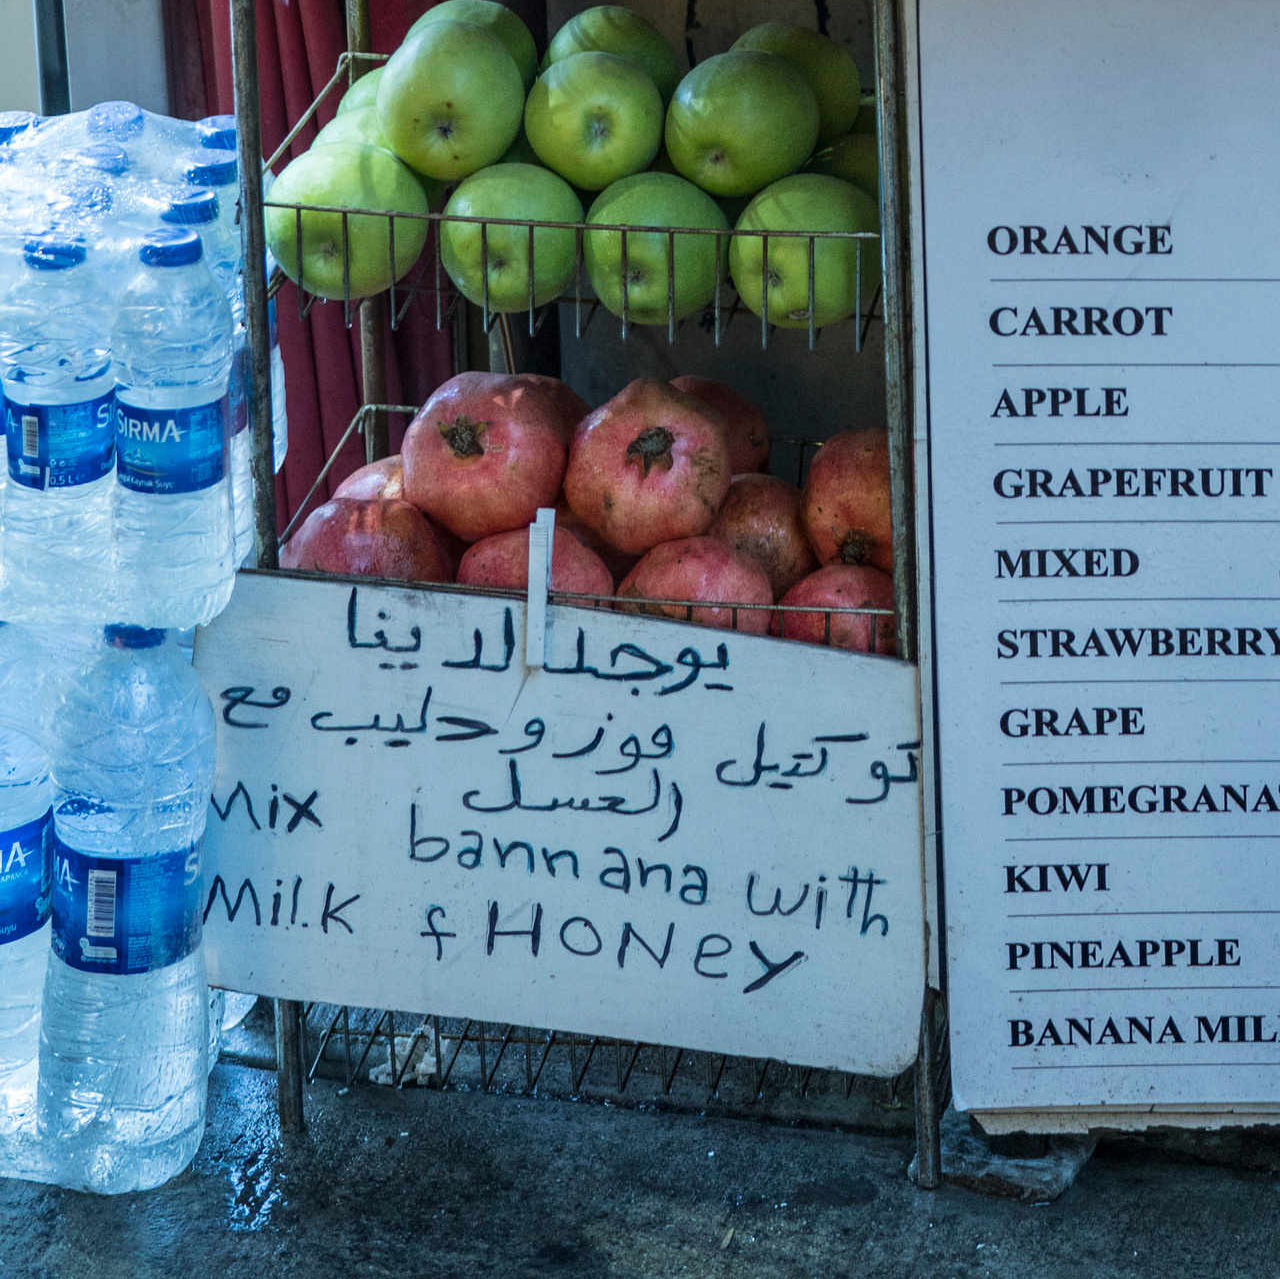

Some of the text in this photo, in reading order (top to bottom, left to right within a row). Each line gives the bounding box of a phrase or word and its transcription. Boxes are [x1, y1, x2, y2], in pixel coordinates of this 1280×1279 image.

[987, 225, 1173, 256] ORANGE
[988, 306, 1173, 338] CARROT
[990, 388, 1129, 418] APPLE
[993, 468, 1273, 499] GRAPEFRUIT
[995, 549, 1140, 579] MIXED
[1000, 707, 1145, 738] GRAPE
[1003, 863, 1110, 895] KIWI
[746, 866, 888, 937] with
[0, 924, 17, 935] uyu
[1005, 939, 1241, 971] PINEAPPLE
[1007, 1016, 1186, 1048] BANANA
